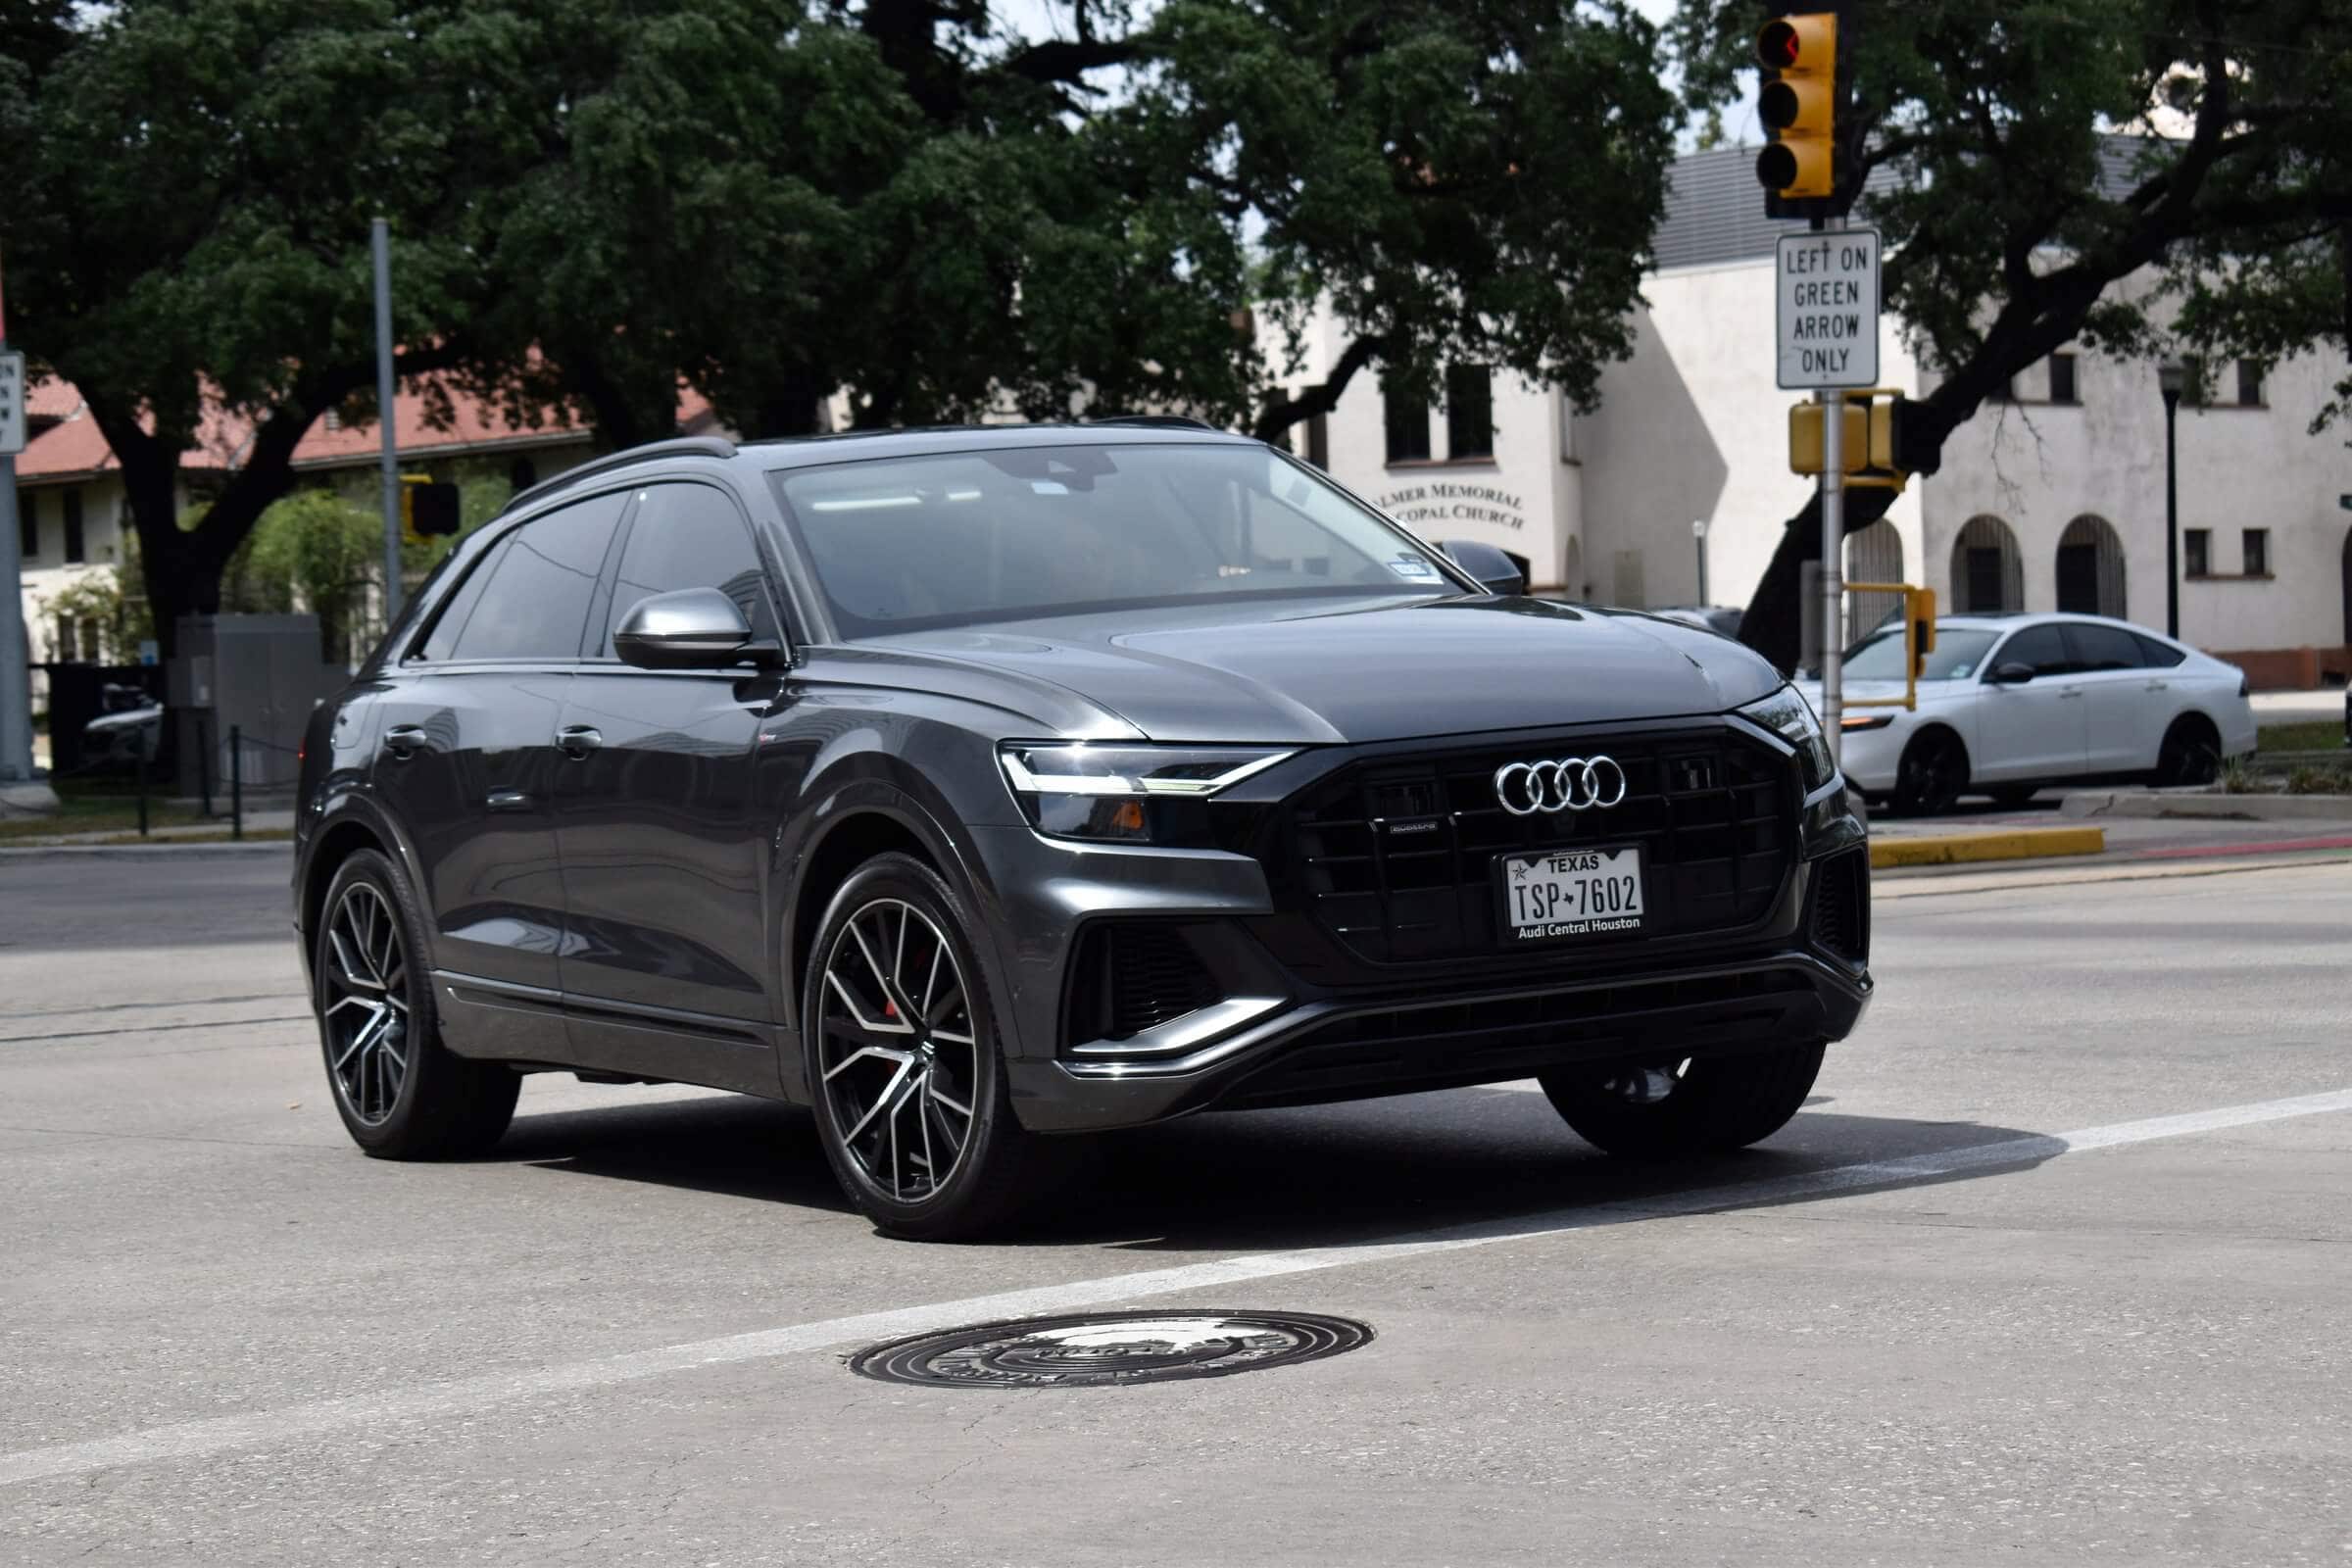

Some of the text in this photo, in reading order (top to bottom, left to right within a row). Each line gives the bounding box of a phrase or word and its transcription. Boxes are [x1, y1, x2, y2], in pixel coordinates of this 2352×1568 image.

[1787, 246, 1868, 274] LEFT ON
[1794, 281, 1859, 307] GREEN
[1793, 315, 1860, 340] ARROW
[1801, 348, 1849, 373] ONLY
[1374, 483, 1523, 511] LMER MEMORIAL
[1452, 504, 1524, 530] CHURCH
[1547, 856, 1599, 874] TEXAS
[1515, 875, 1637, 921] TSP 7602
[1518, 917, 1641, 939] Audi Central Houston
